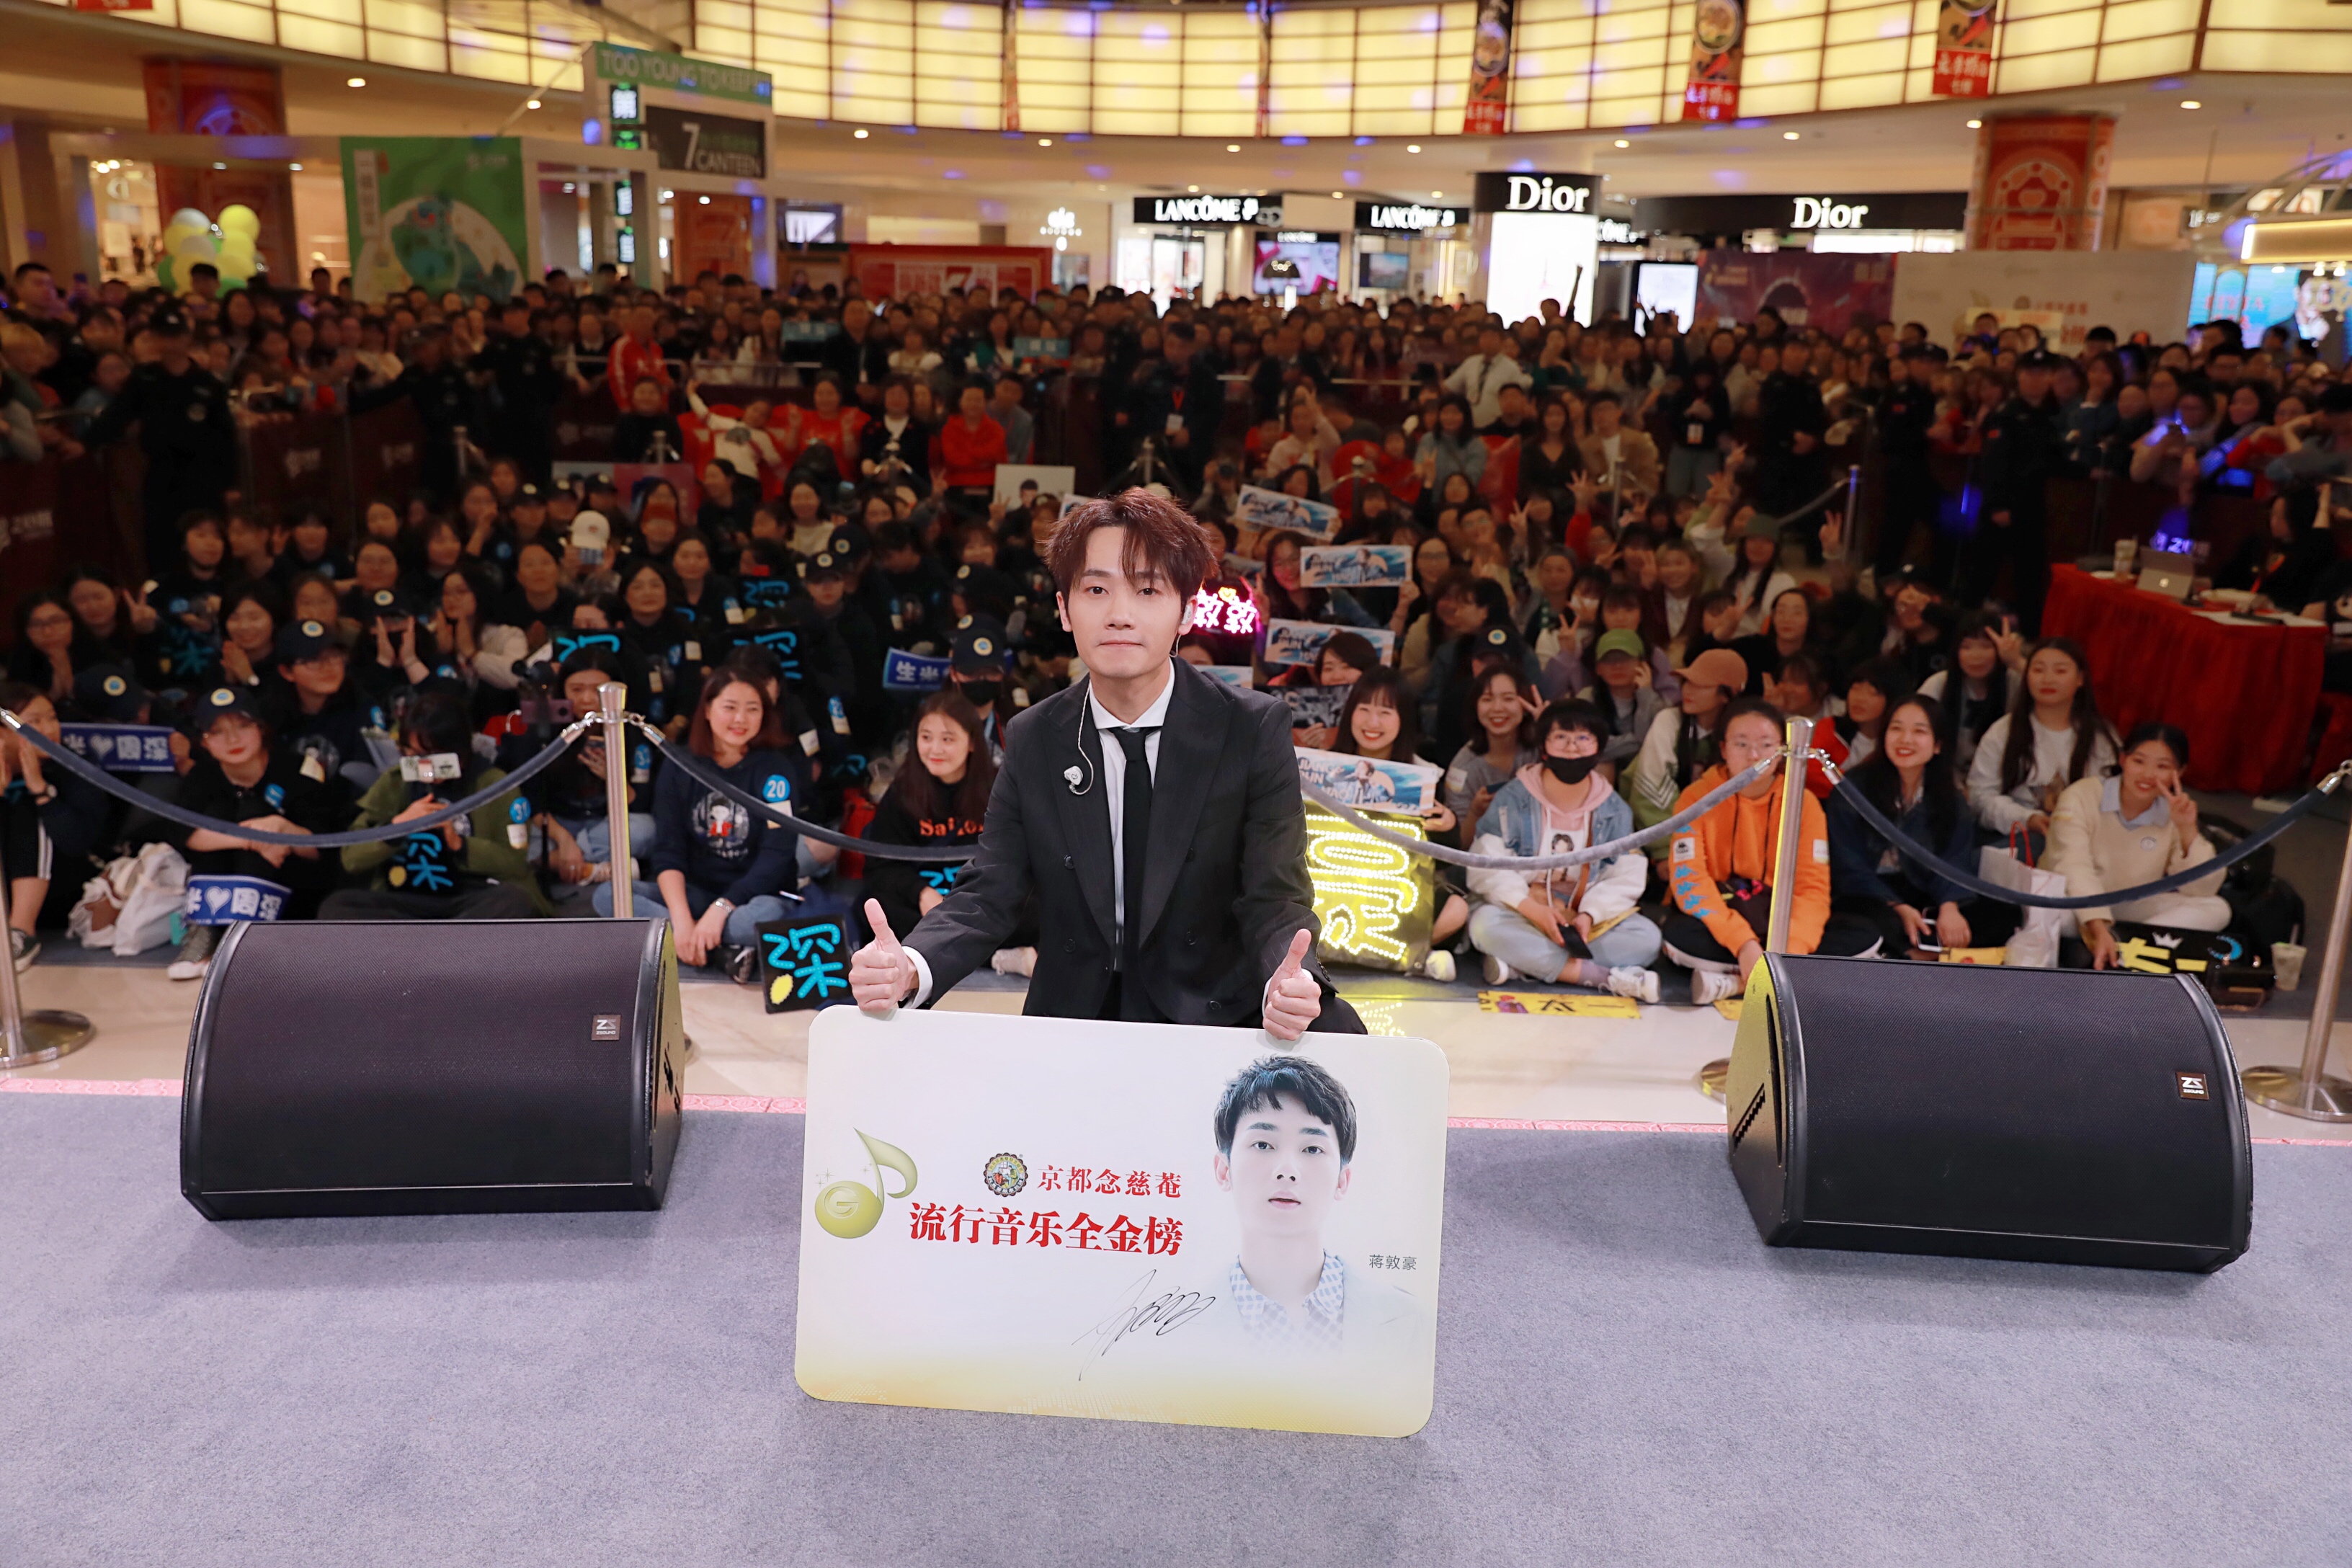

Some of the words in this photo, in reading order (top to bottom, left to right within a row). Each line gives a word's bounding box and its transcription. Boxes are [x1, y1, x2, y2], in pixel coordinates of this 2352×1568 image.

[681, 122, 700, 169] 7
[1505, 176, 1590, 212] Dior
[1790, 197, 1868, 228] Dior
[767, 780, 786, 798] 20
[762, 923, 847, 1004] 深
[1037, 1164, 1182, 1198] 京都念慈菴
[909, 1202, 1183, 1256] 流行音乐全金榜
[1369, 1254, 1417, 1270] 蒋敦豪
